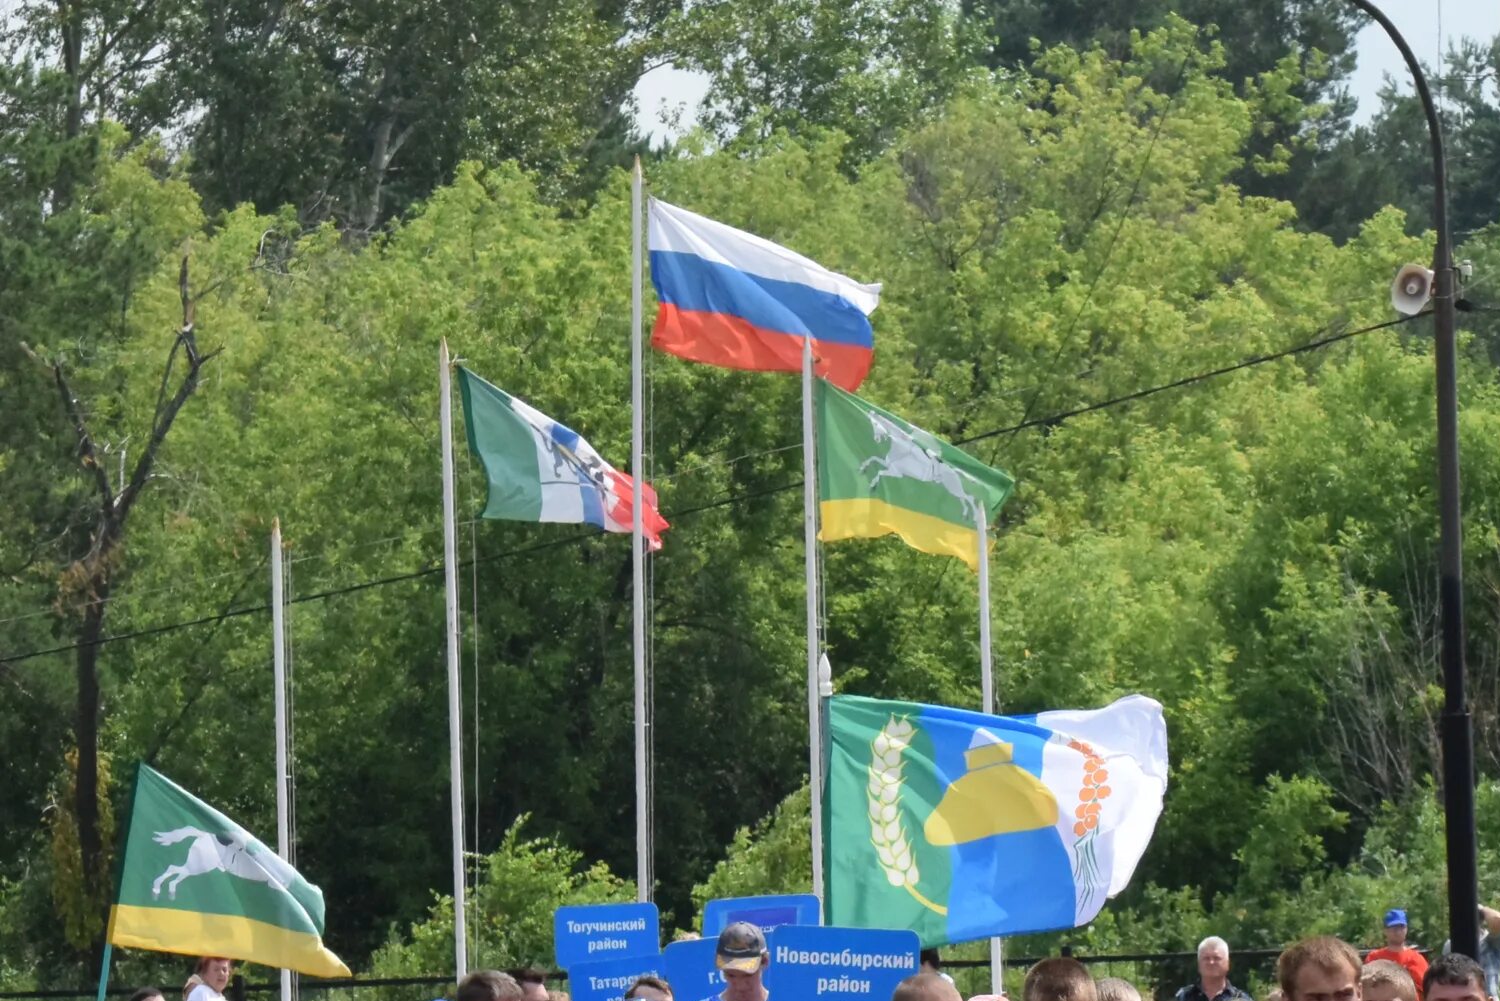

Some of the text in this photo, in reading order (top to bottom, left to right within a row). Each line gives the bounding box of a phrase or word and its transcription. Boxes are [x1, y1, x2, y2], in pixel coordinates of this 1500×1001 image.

[566, 918, 646, 935] Тогучинский
[587, 938, 627, 954] район
[775, 945, 915, 971] Новосибирский
[588, 969, 659, 990] Татарс
[816, 974, 871, 995] район
